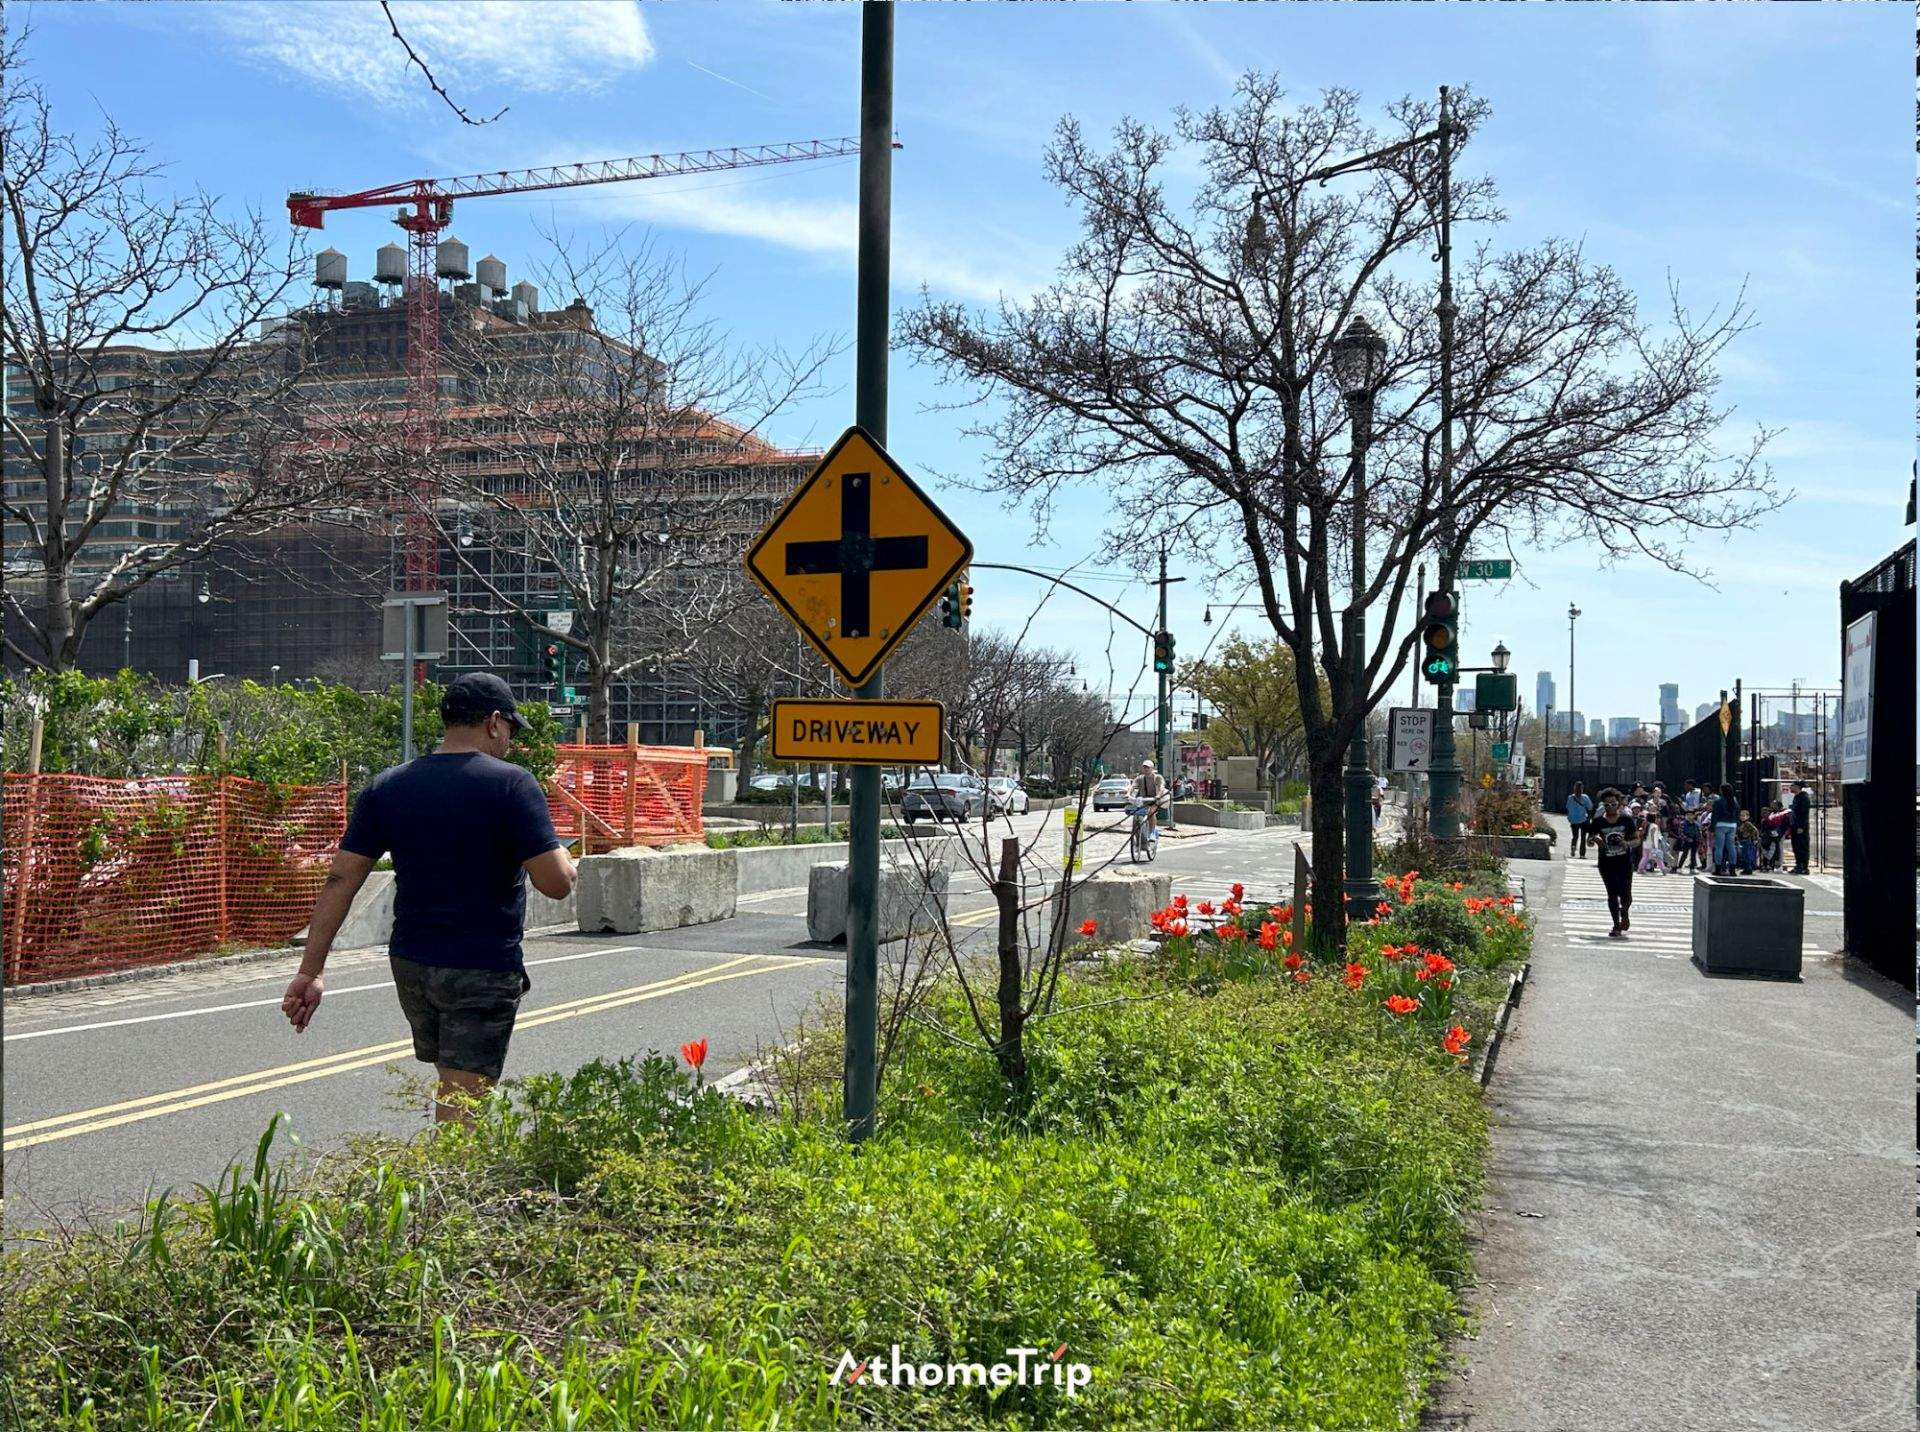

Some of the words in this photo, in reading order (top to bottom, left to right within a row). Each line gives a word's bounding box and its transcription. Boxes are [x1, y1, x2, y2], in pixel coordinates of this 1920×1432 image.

[1476, 562, 1493, 577] 30
[1400, 716, 1426, 726] STOP
[793, 719, 921, 745] DRIVEWAY
